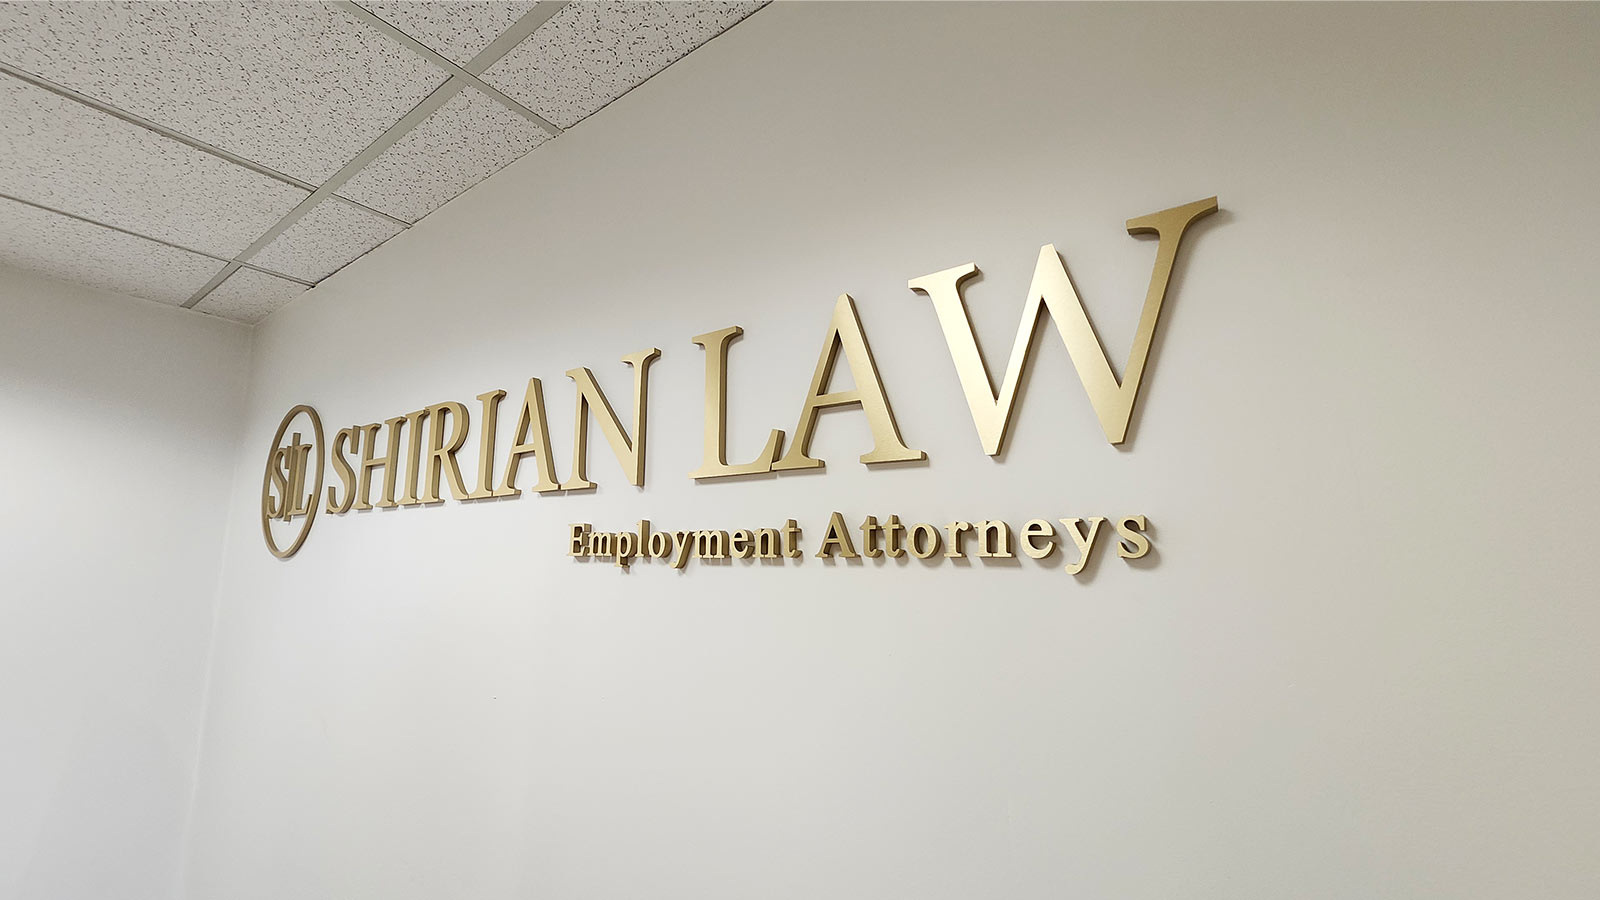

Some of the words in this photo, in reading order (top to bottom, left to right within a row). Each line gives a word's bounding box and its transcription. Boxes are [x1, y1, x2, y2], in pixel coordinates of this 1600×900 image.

[326, 347, 661, 514] SHIRIAN
[689, 196, 1218, 479] LAW
[567, 518, 803, 568] Employment
[815, 511, 1151, 575] Attorneys
